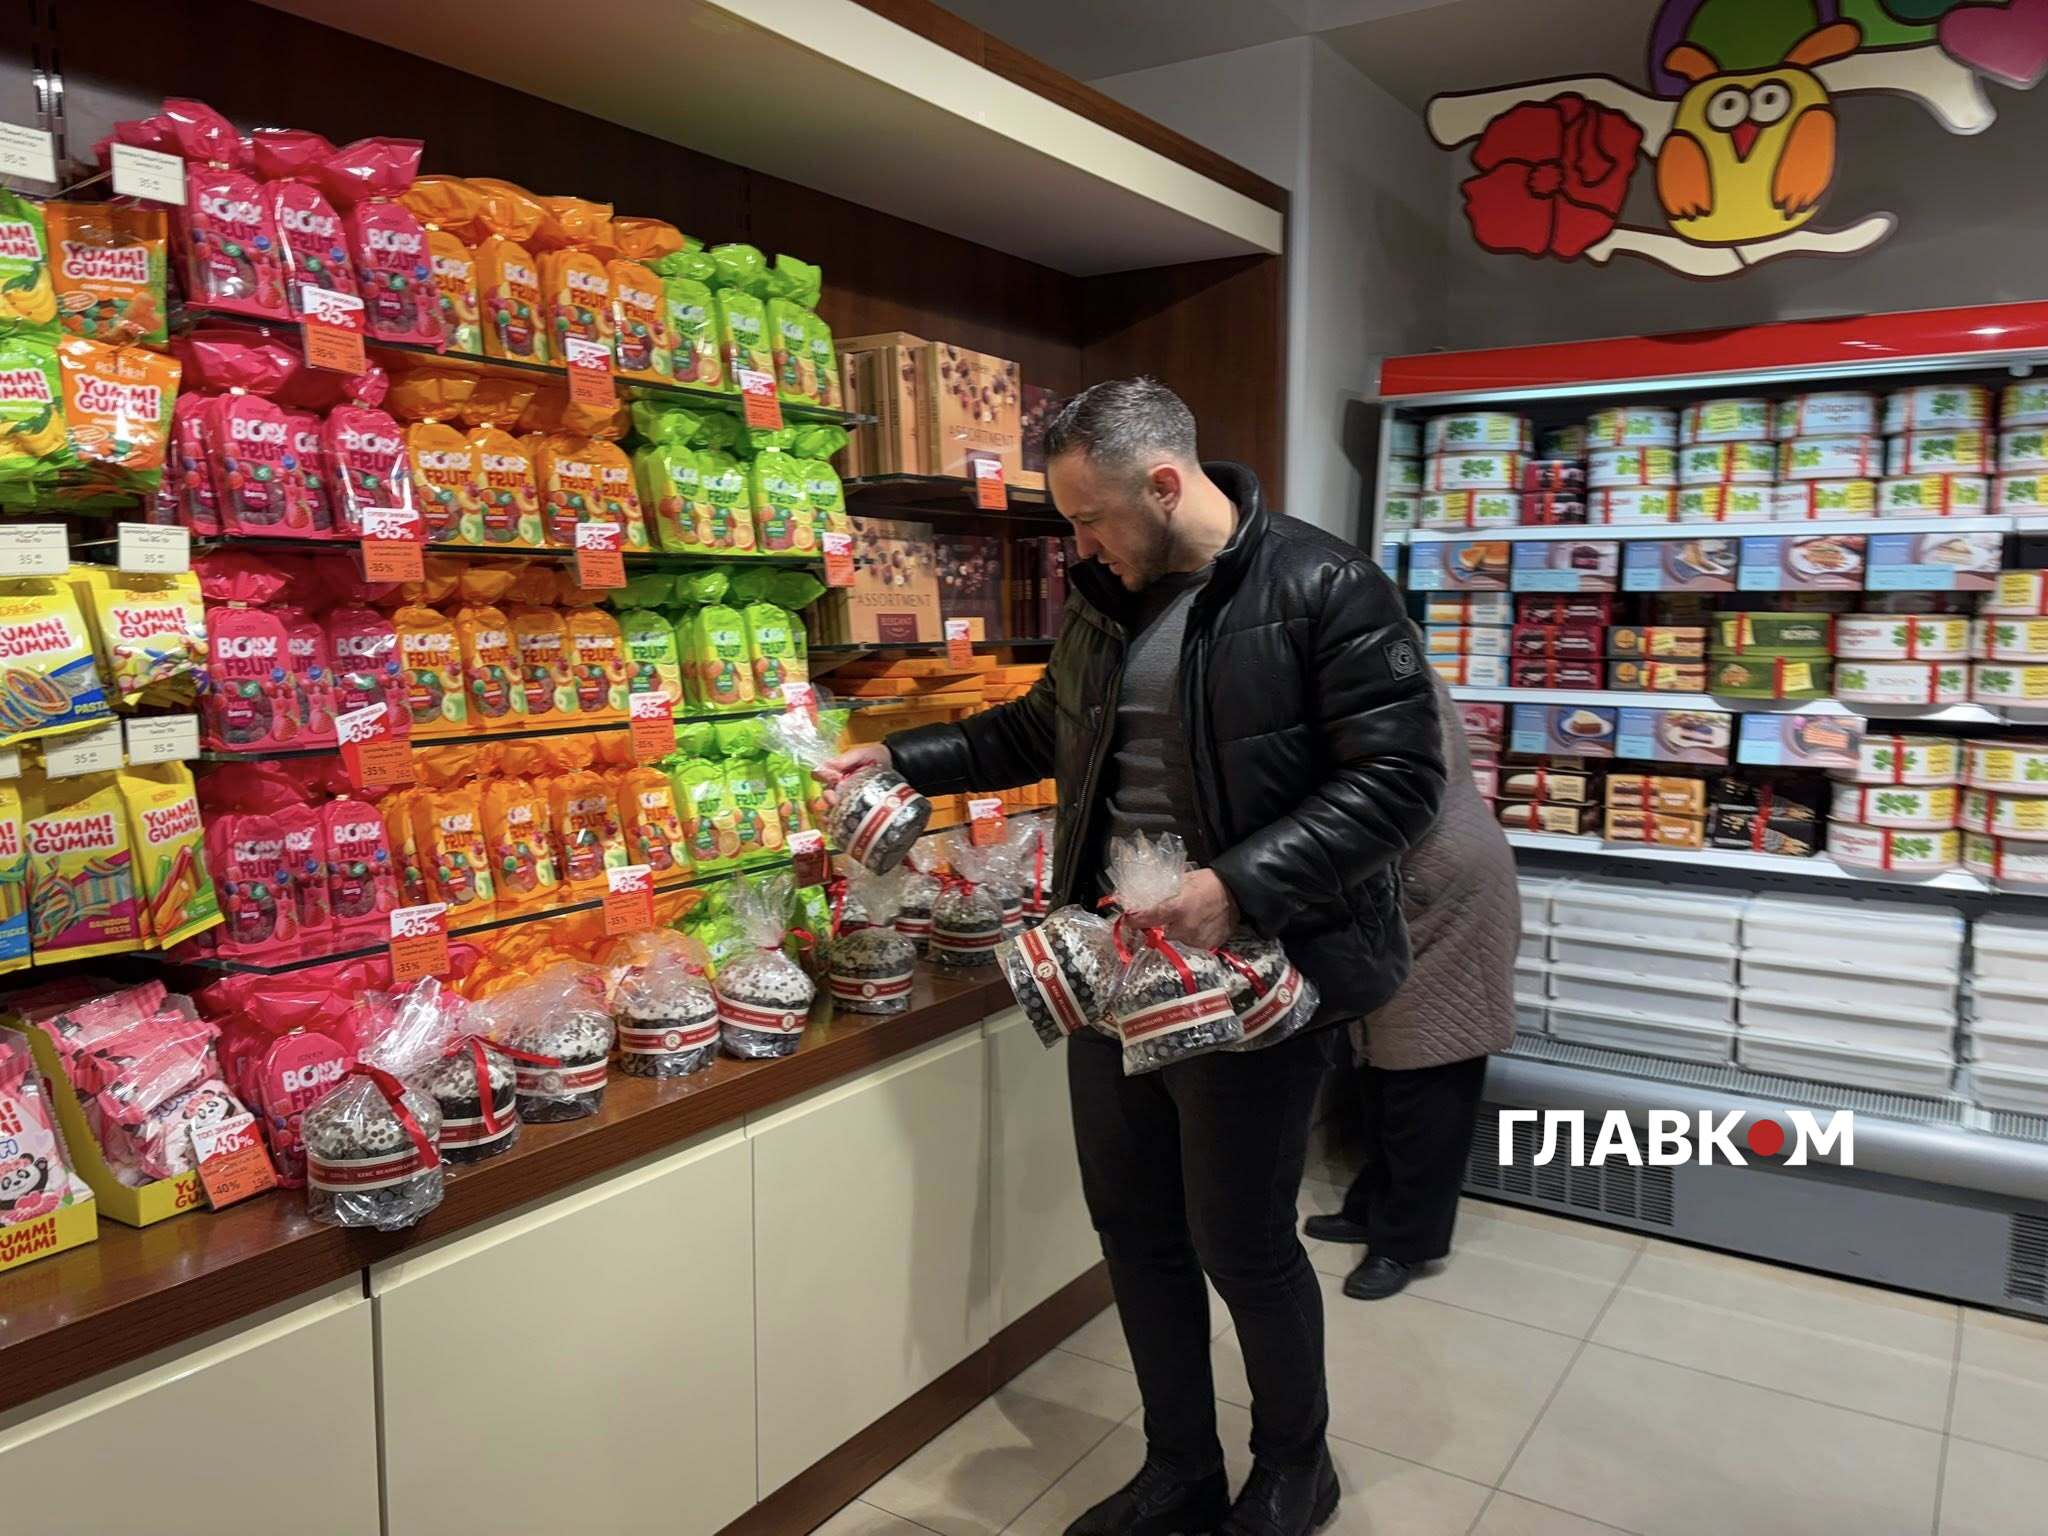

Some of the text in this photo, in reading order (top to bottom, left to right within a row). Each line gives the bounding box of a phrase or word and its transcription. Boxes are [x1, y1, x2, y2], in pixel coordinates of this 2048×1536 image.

[313, 302, 356, 328] -35%
[373, 520, 415, 540] -35%
[583, 533, 616, 550] -35%
[636, 703, 667, 718] -35%
[345, 720, 385, 743] -35%
[33, 834, 114, 854] GUMMI
[617, 876, 647, 891] -35%
[399, 917, 441, 938] -35%
[205, 1133, 255, 1155] -40%
[212, 1181, 241, 1195] -40%
